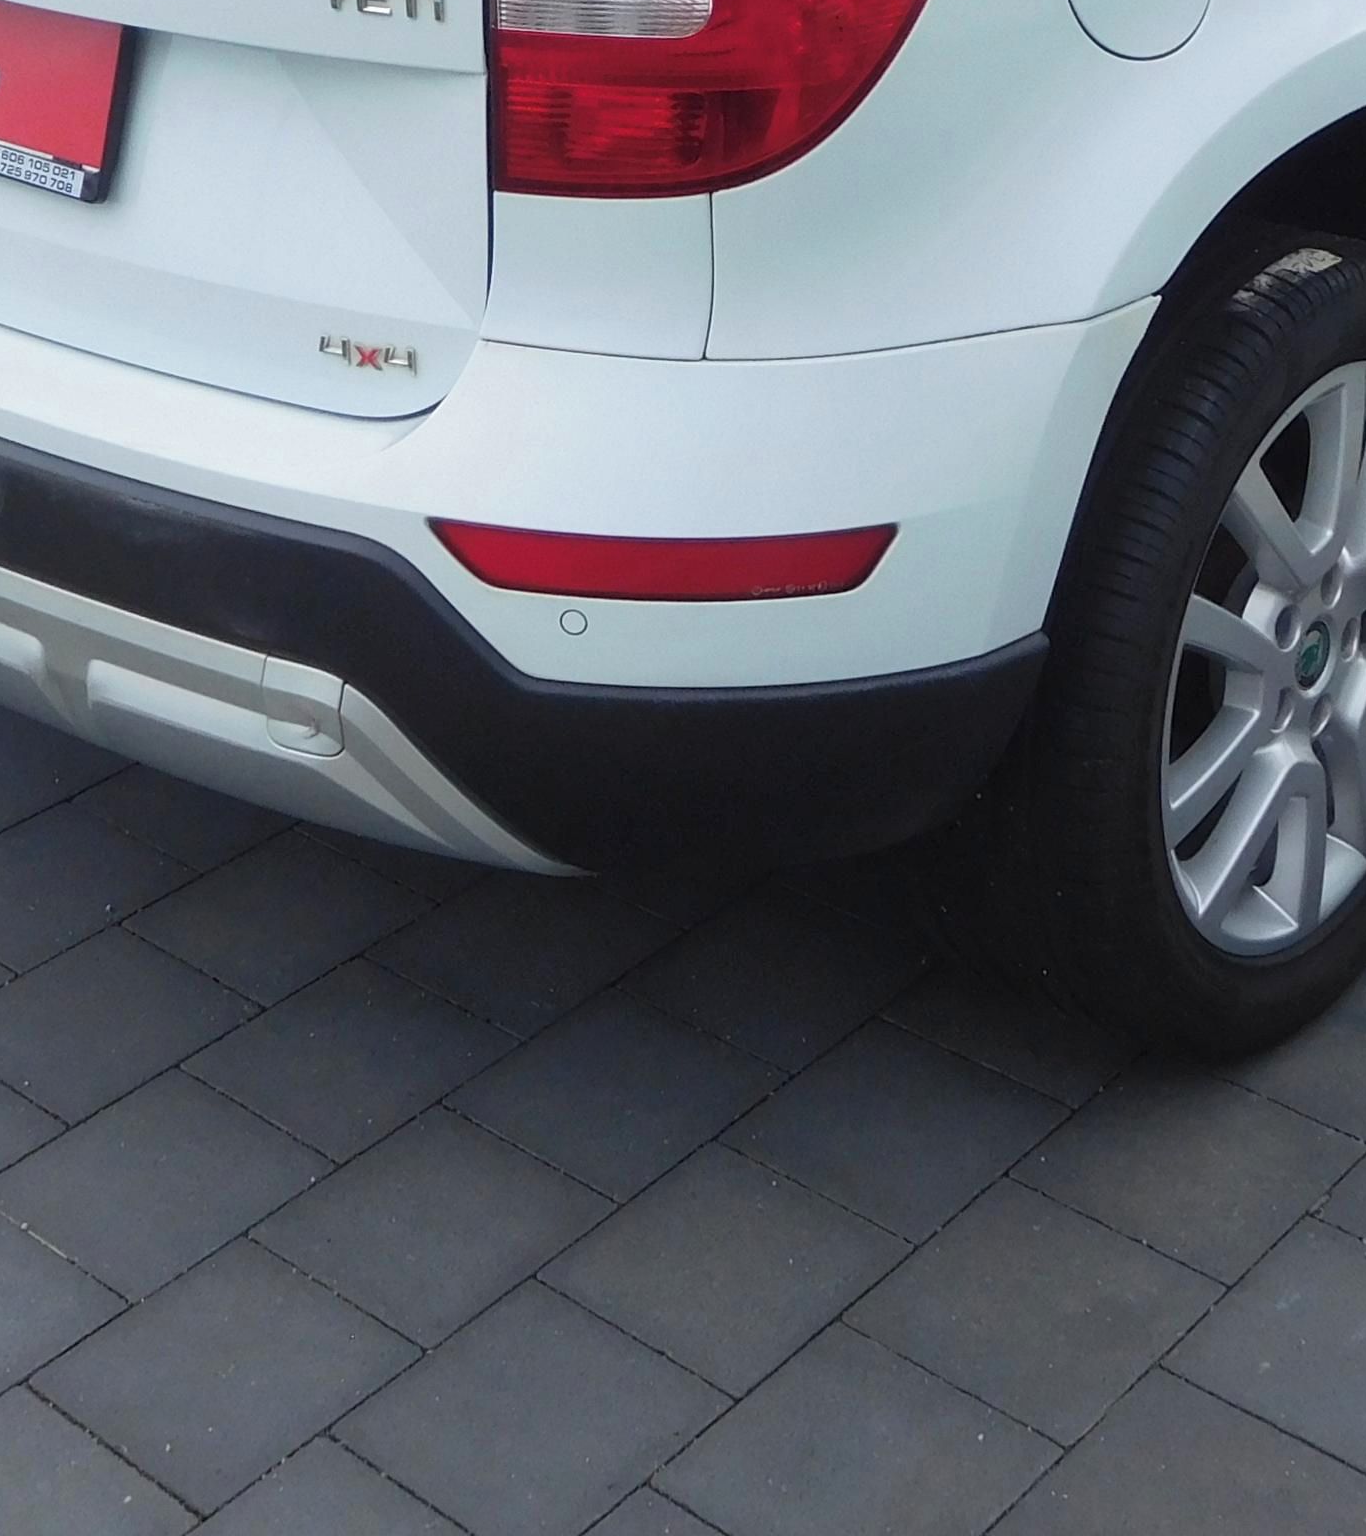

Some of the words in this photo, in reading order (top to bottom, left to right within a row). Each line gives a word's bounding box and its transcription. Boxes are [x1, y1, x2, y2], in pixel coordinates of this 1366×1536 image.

[0, 162, 23, 178] 725
[23, 170, 48, 185] 970
[49, 177, 73, 194] 708
[28, 157, 51, 173] 105
[52, 164, 76, 181] 021
